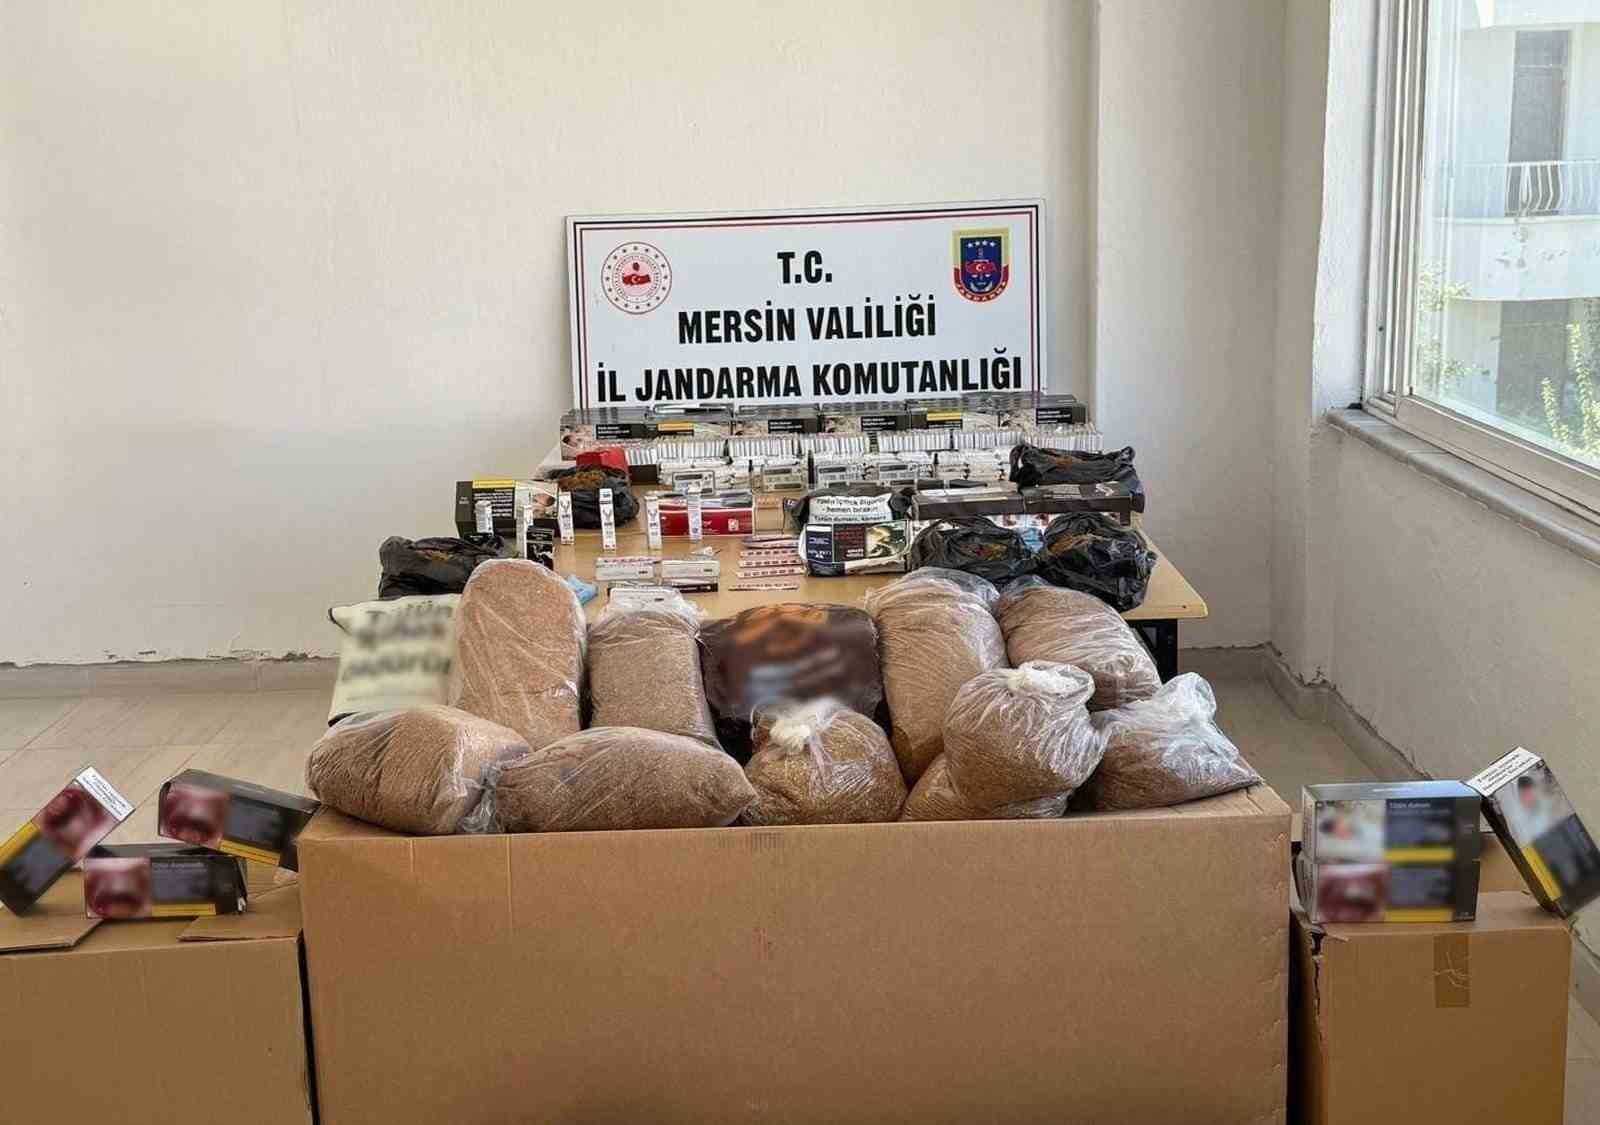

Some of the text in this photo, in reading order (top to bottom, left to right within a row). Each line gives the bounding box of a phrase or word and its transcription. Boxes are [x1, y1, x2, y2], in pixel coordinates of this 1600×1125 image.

[777, 250, 833, 284] T.C.
[678, 293, 937, 344] MERSİN VALİLİĞİ
[597, 347, 1022, 402] İL JANDARMA KOMUTANLIĞI
